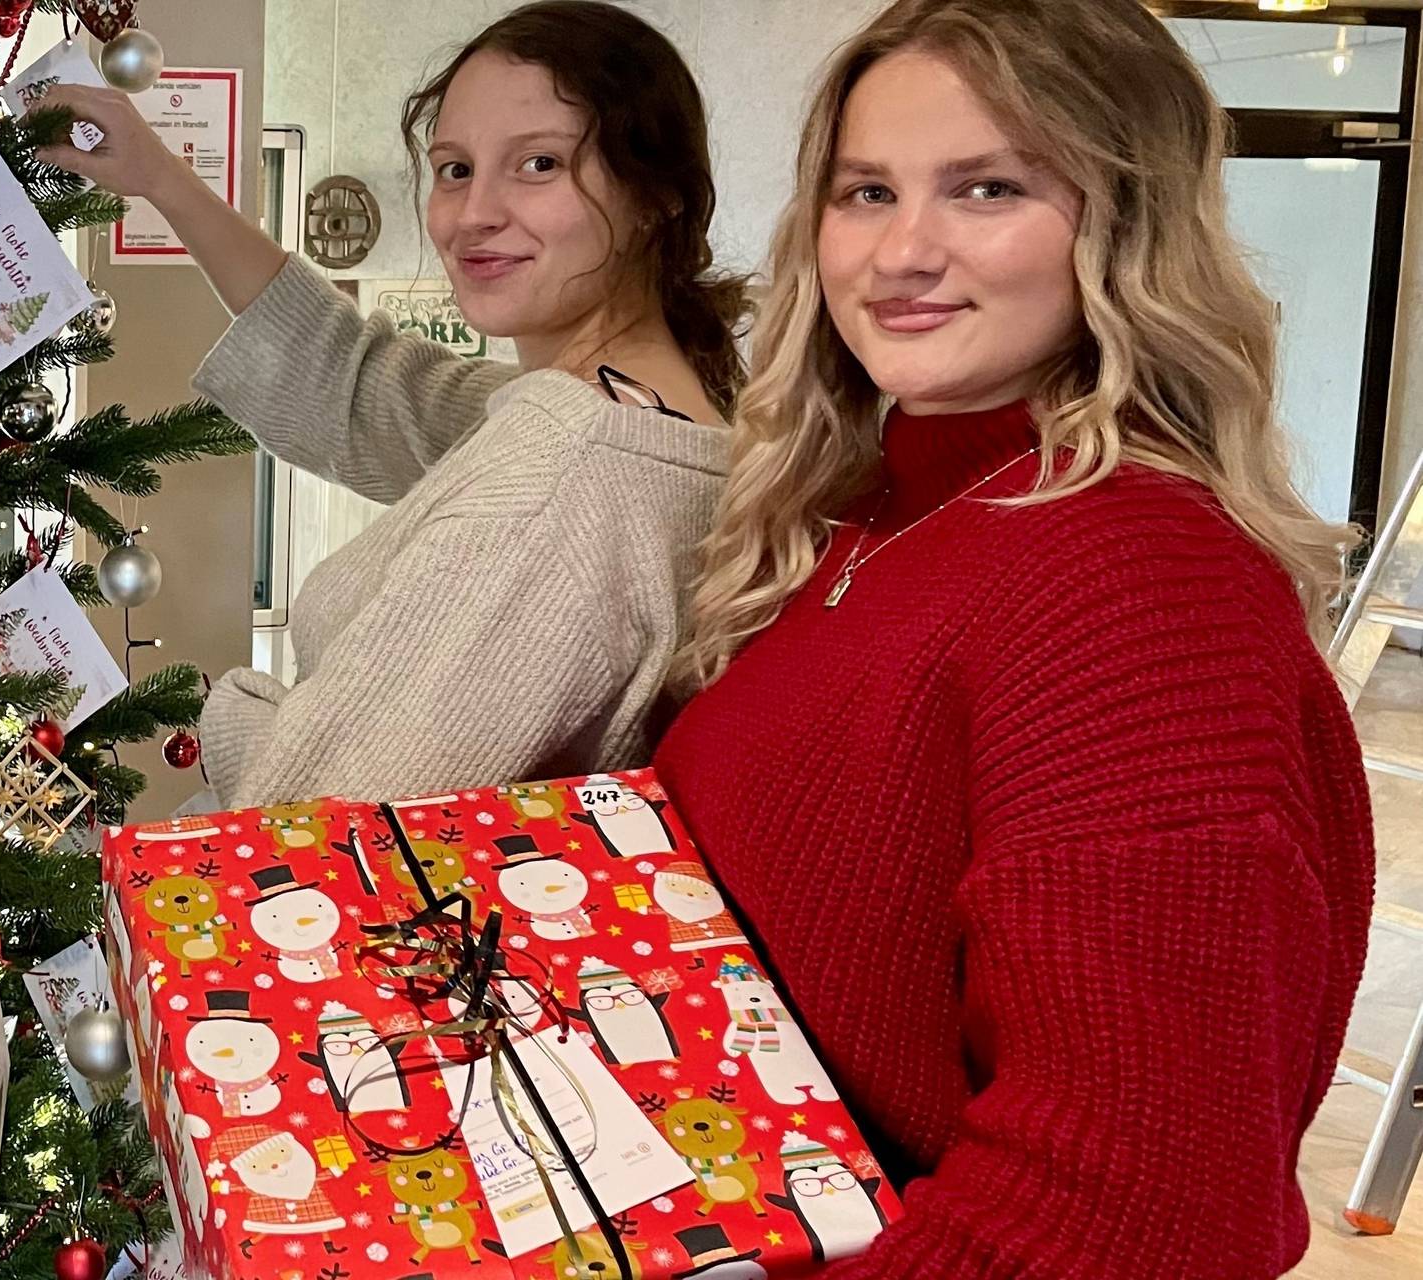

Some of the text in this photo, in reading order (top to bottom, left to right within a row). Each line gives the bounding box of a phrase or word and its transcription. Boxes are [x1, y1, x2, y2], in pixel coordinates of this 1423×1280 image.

[1, 224, 30, 261] Frohe
[24, 618, 69, 683] Weihnacht
[49, 626, 73, 658] Frohe
[582, 790, 621, 805] 247
